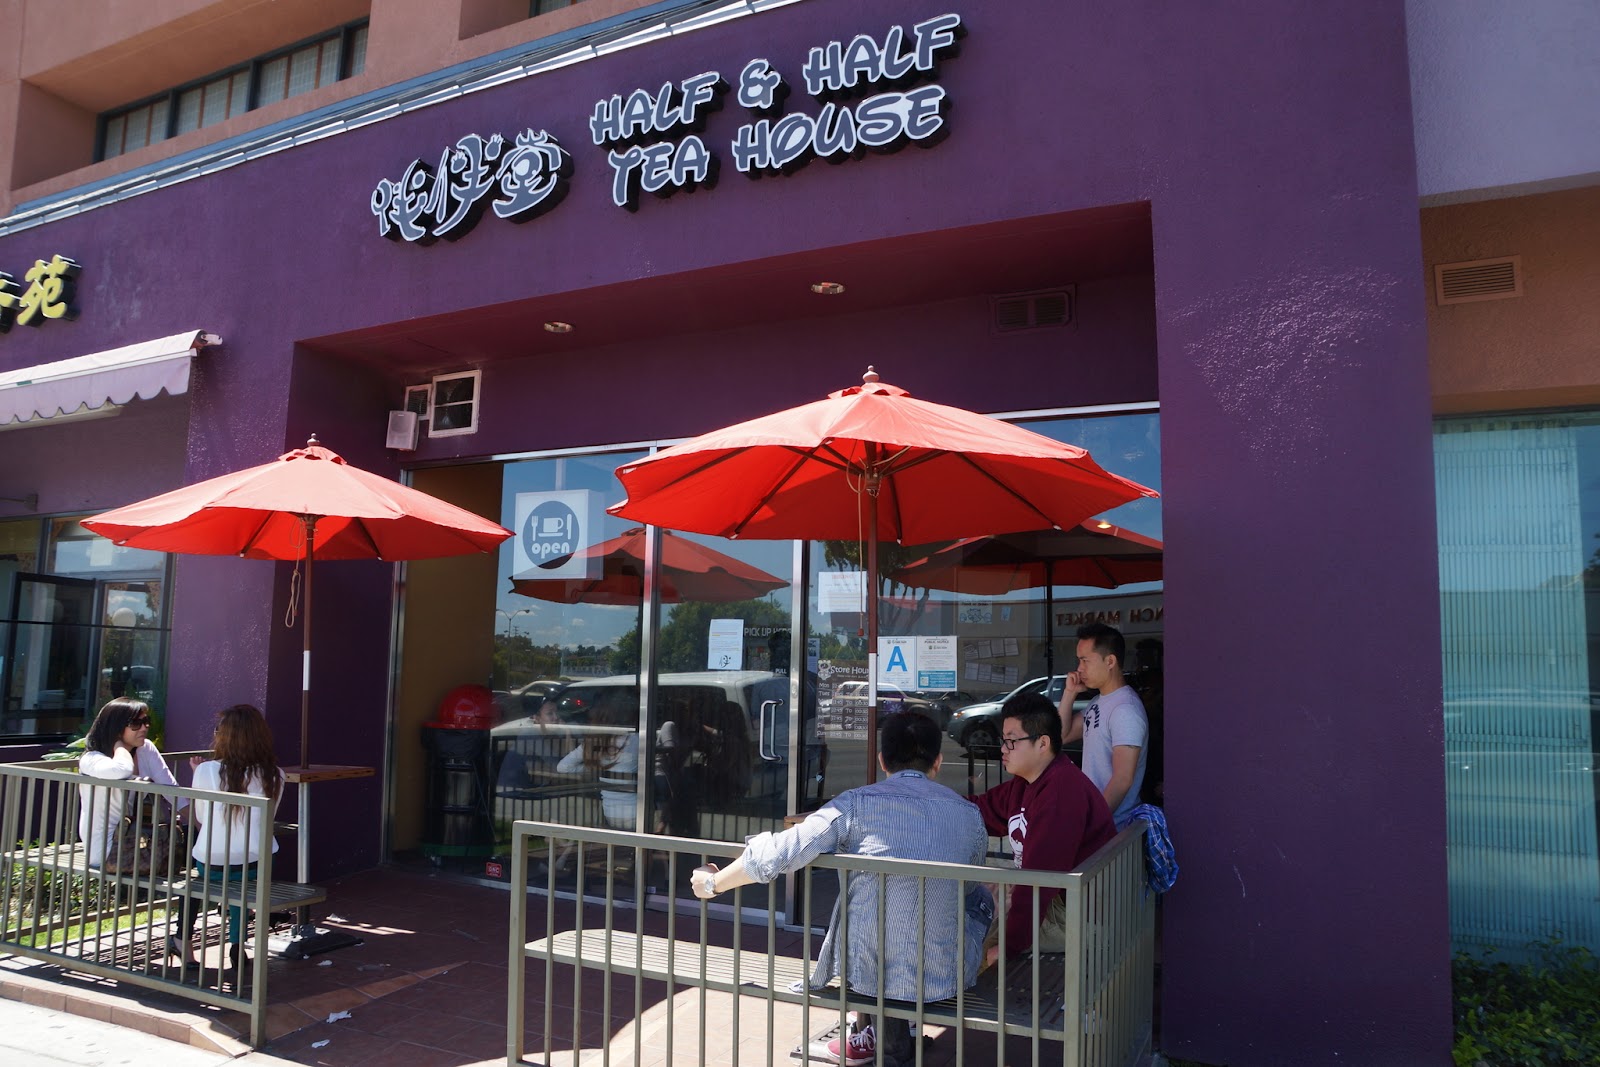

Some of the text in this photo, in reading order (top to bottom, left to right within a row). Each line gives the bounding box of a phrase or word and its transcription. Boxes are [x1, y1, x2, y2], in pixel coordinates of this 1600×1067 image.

[590, 13, 960, 145] HALF & HALF
[608, 85, 946, 207] TEA HOUSE
[0, 253, 68, 326] 苑
[531, 542, 570, 559] open
[744, 627, 760, 637] PICK
[761, 628, 771, 637] UP
[831, 666, 850, 674] Store
[886, 645, 908, 672] A
